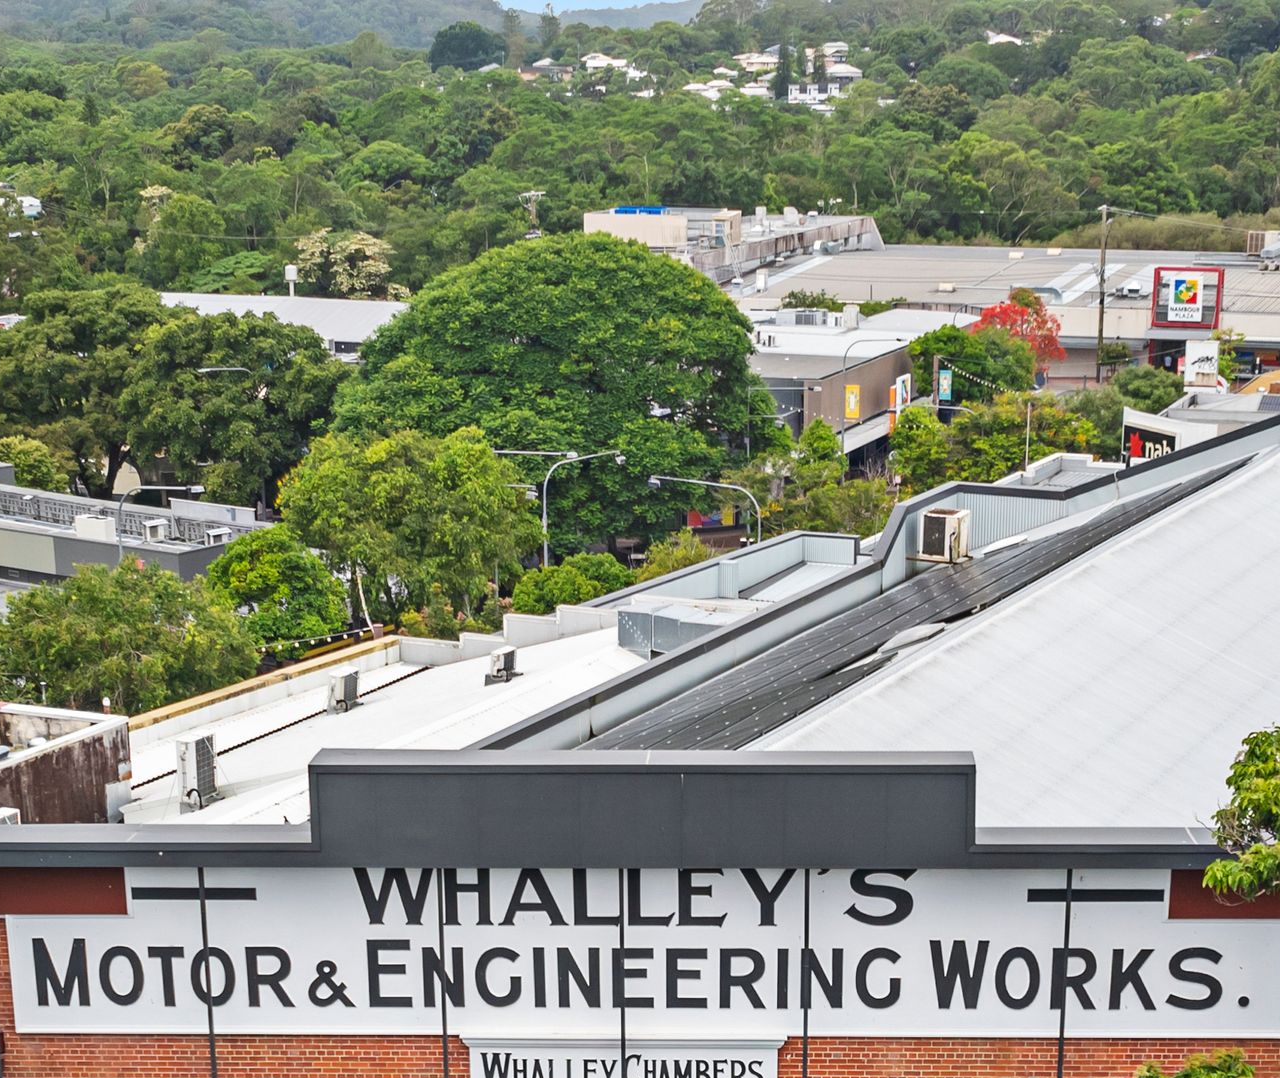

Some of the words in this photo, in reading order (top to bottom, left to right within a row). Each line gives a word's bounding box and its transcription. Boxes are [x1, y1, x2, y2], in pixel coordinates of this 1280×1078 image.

[1145, 440, 1172, 459] nab
[354, 868, 916, 927] WHALLEYS
[32, 938, 296, 1008] MOTOR
[308, 960, 356, 1008] &
[367, 939, 902, 1010] ENGINEERING
[929, 939, 1251, 1011] WORKS.
